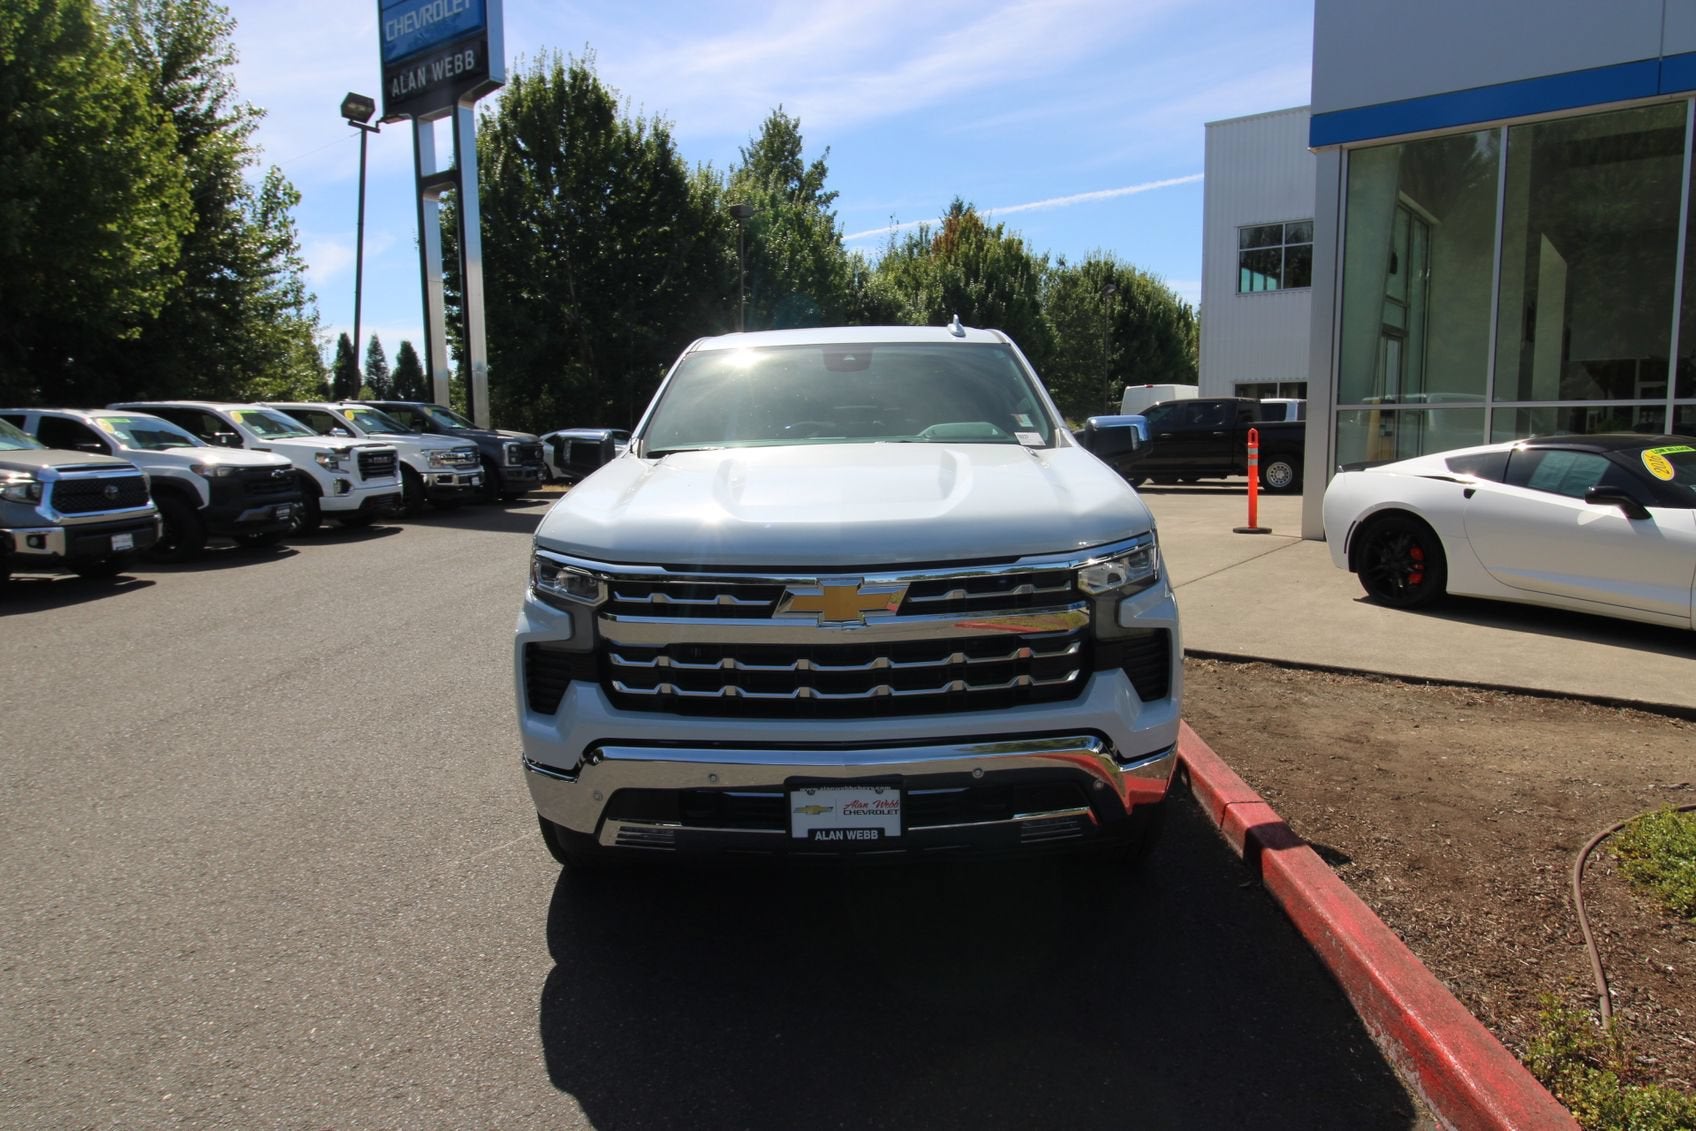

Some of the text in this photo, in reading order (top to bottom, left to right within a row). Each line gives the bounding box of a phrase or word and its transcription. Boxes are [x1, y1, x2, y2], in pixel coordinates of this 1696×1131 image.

[391, 49, 475, 98] ALAN WEBB
[844, 799, 899, 810] Alan Webb
[814, 829, 879, 841] ALAN WEBB
